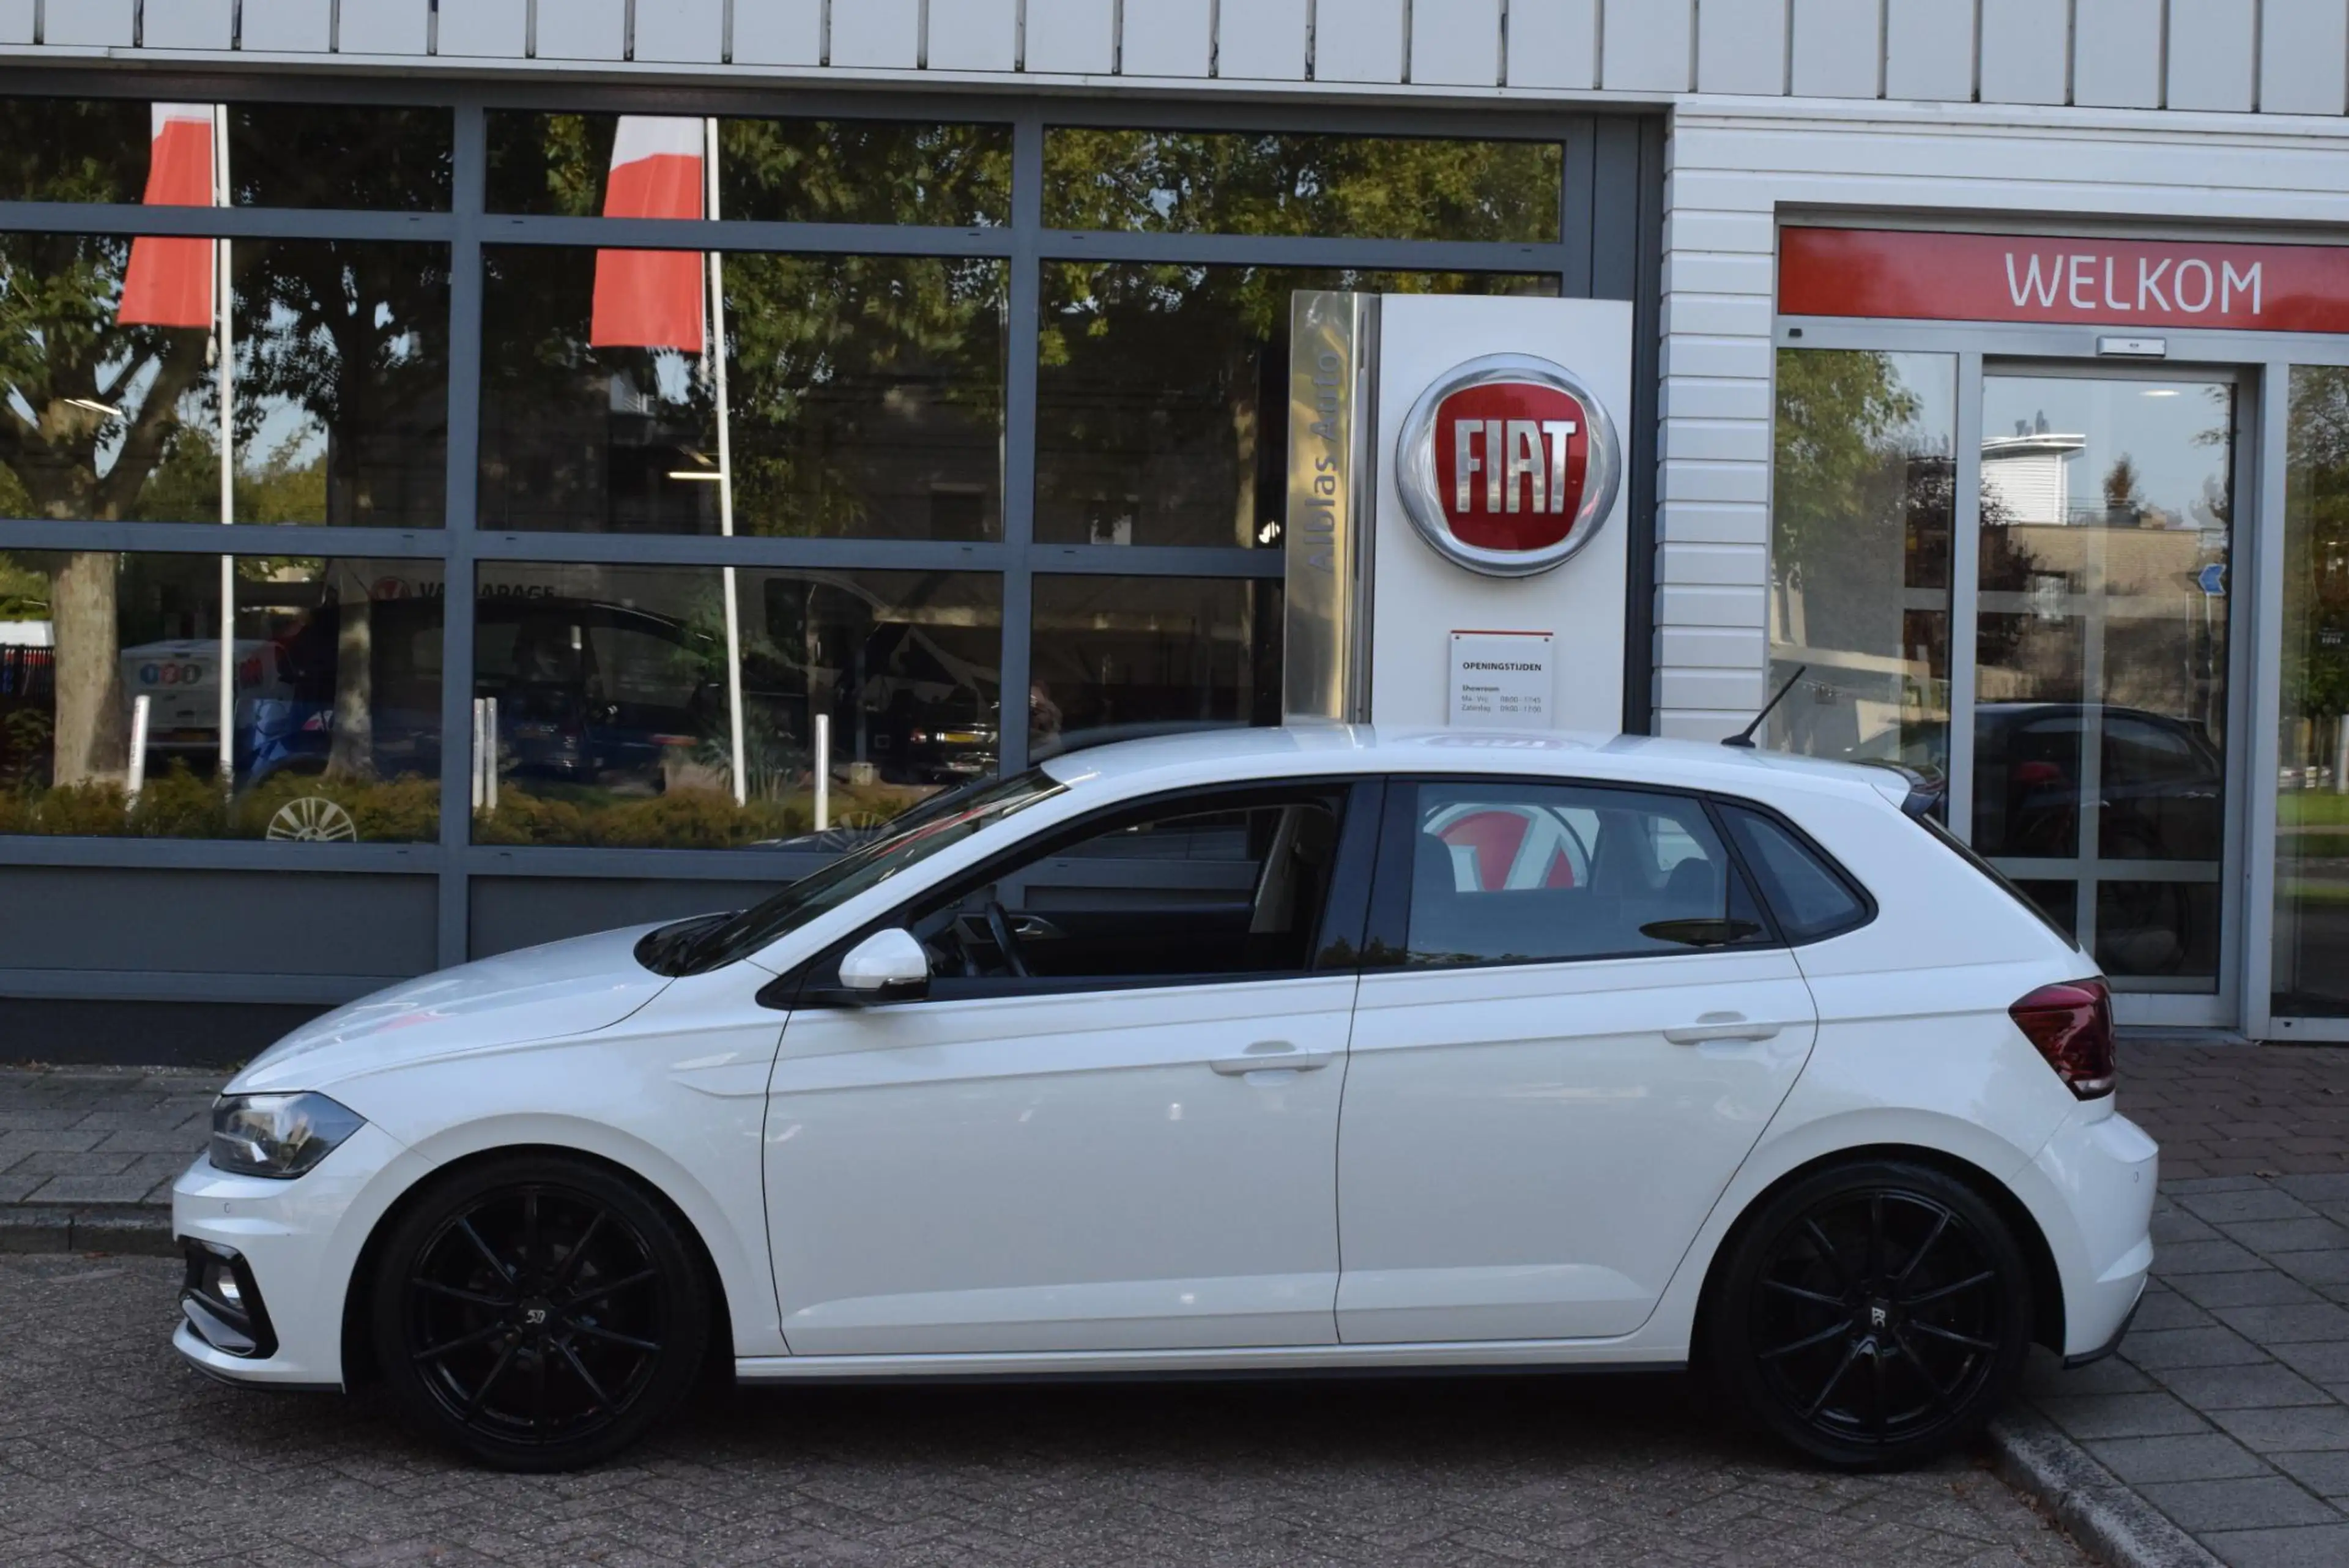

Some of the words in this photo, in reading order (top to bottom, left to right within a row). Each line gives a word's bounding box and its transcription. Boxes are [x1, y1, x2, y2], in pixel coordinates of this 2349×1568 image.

[2005, 252, 2263, 315] WELKOM
[1310, 351, 1340, 442] Auto
[1455, 419, 1576, 514] FIAT
[1304, 456, 1337, 574] Alblas
[1463, 662, 1542, 671] OPENINGSTIJDEN
